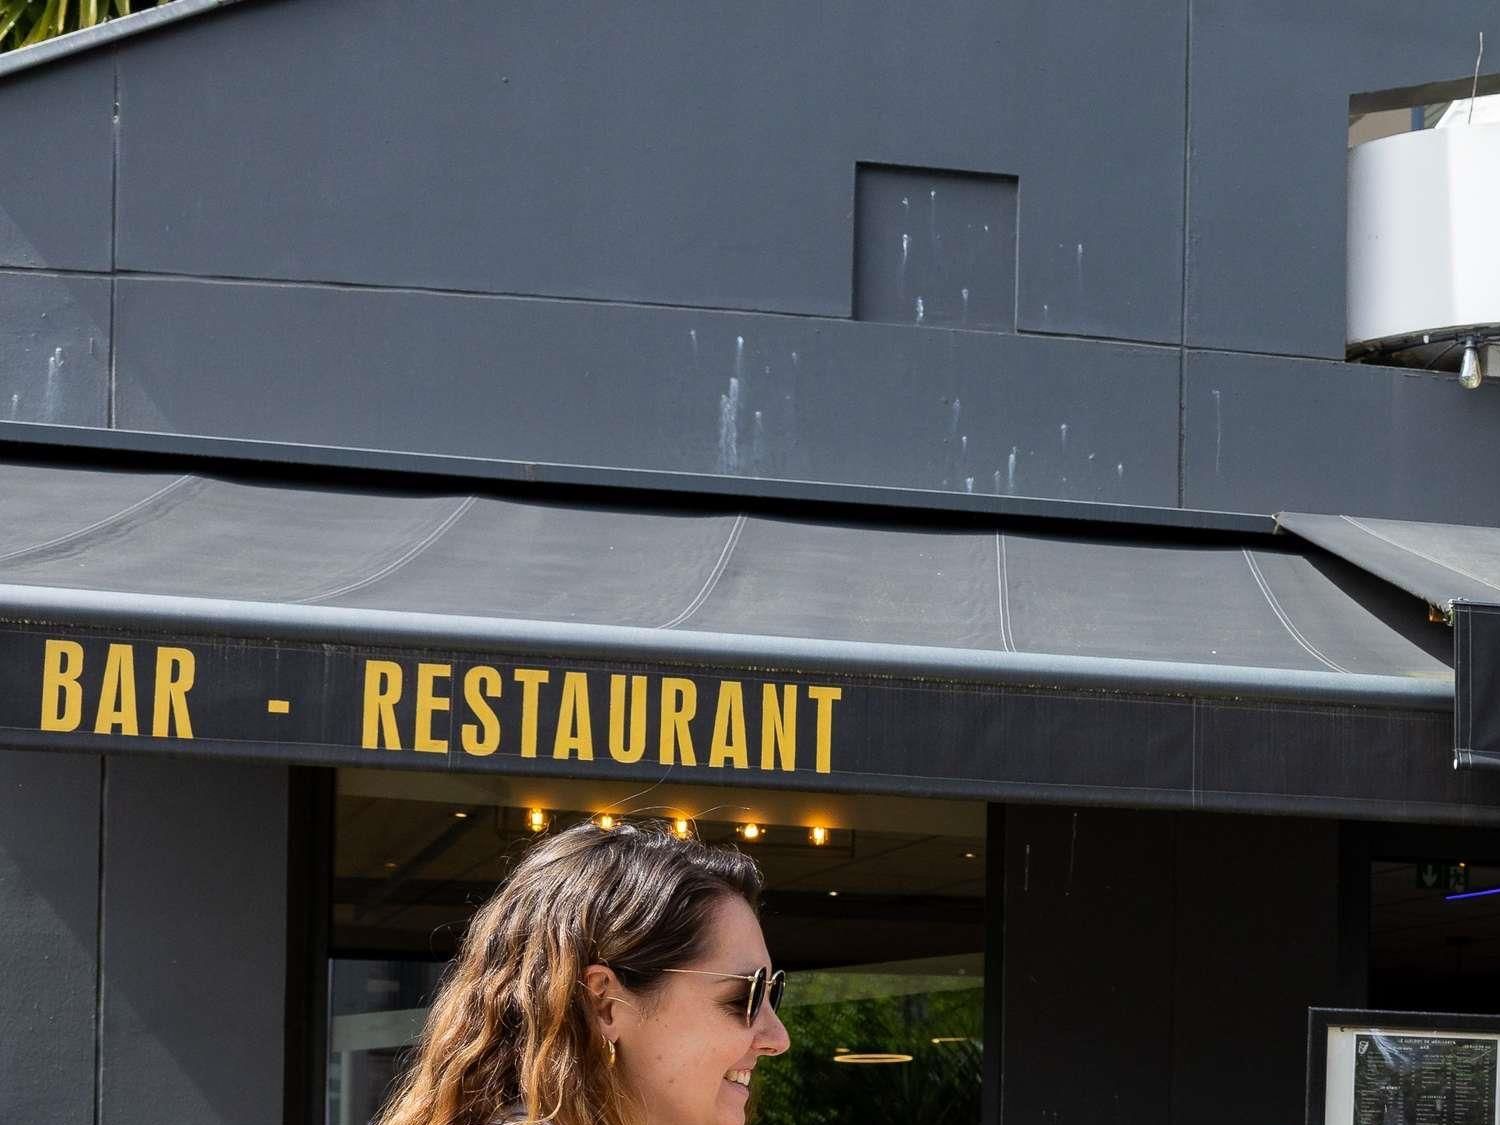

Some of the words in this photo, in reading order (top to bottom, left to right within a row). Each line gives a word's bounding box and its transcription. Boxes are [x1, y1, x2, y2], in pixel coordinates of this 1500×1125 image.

[40, 639, 196, 739] BAR
[267, 699, 290, 714] -
[361, 660, 842, 774] RESTAURANT
